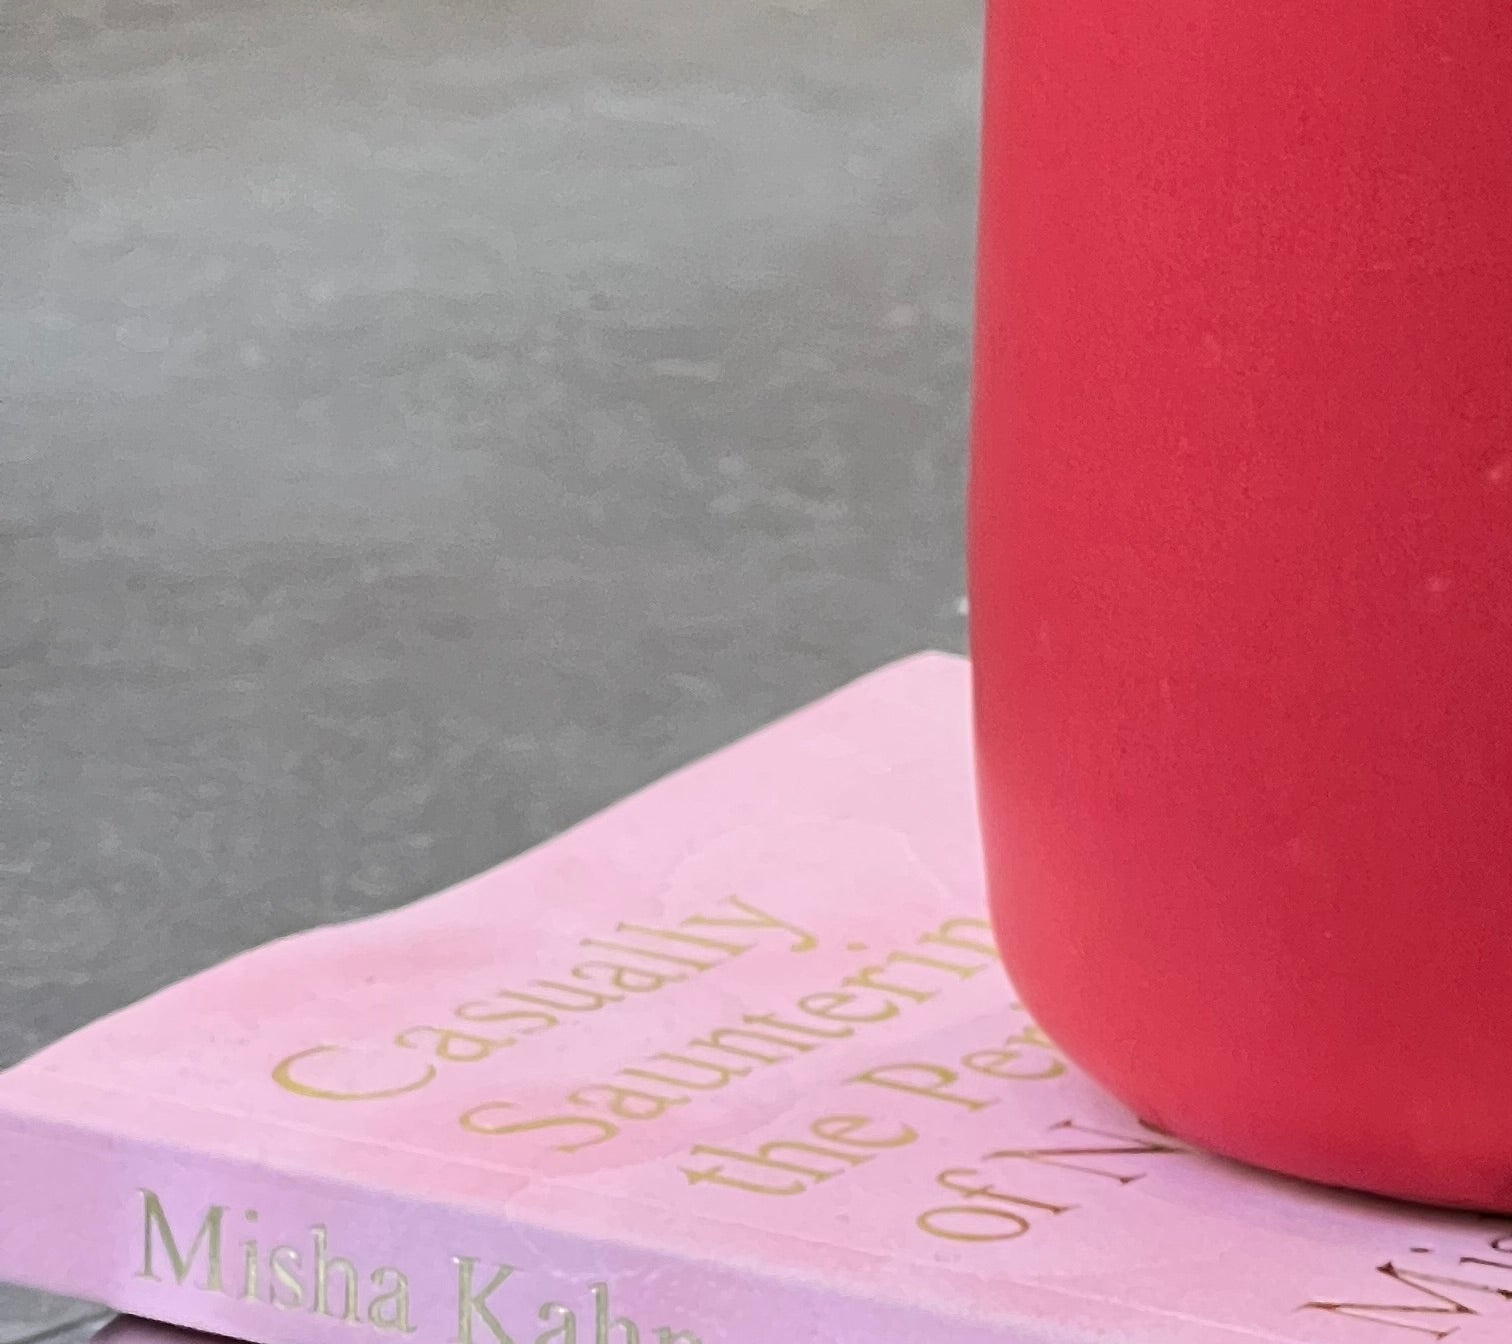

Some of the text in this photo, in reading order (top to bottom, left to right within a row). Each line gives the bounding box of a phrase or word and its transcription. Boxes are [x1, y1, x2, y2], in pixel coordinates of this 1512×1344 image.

[272, 894, 818, 1102] Casually
[677, 1115, 919, 1197] the
[916, 1167, 1082, 1243] of
[134, 1187, 417, 1333] Misha
